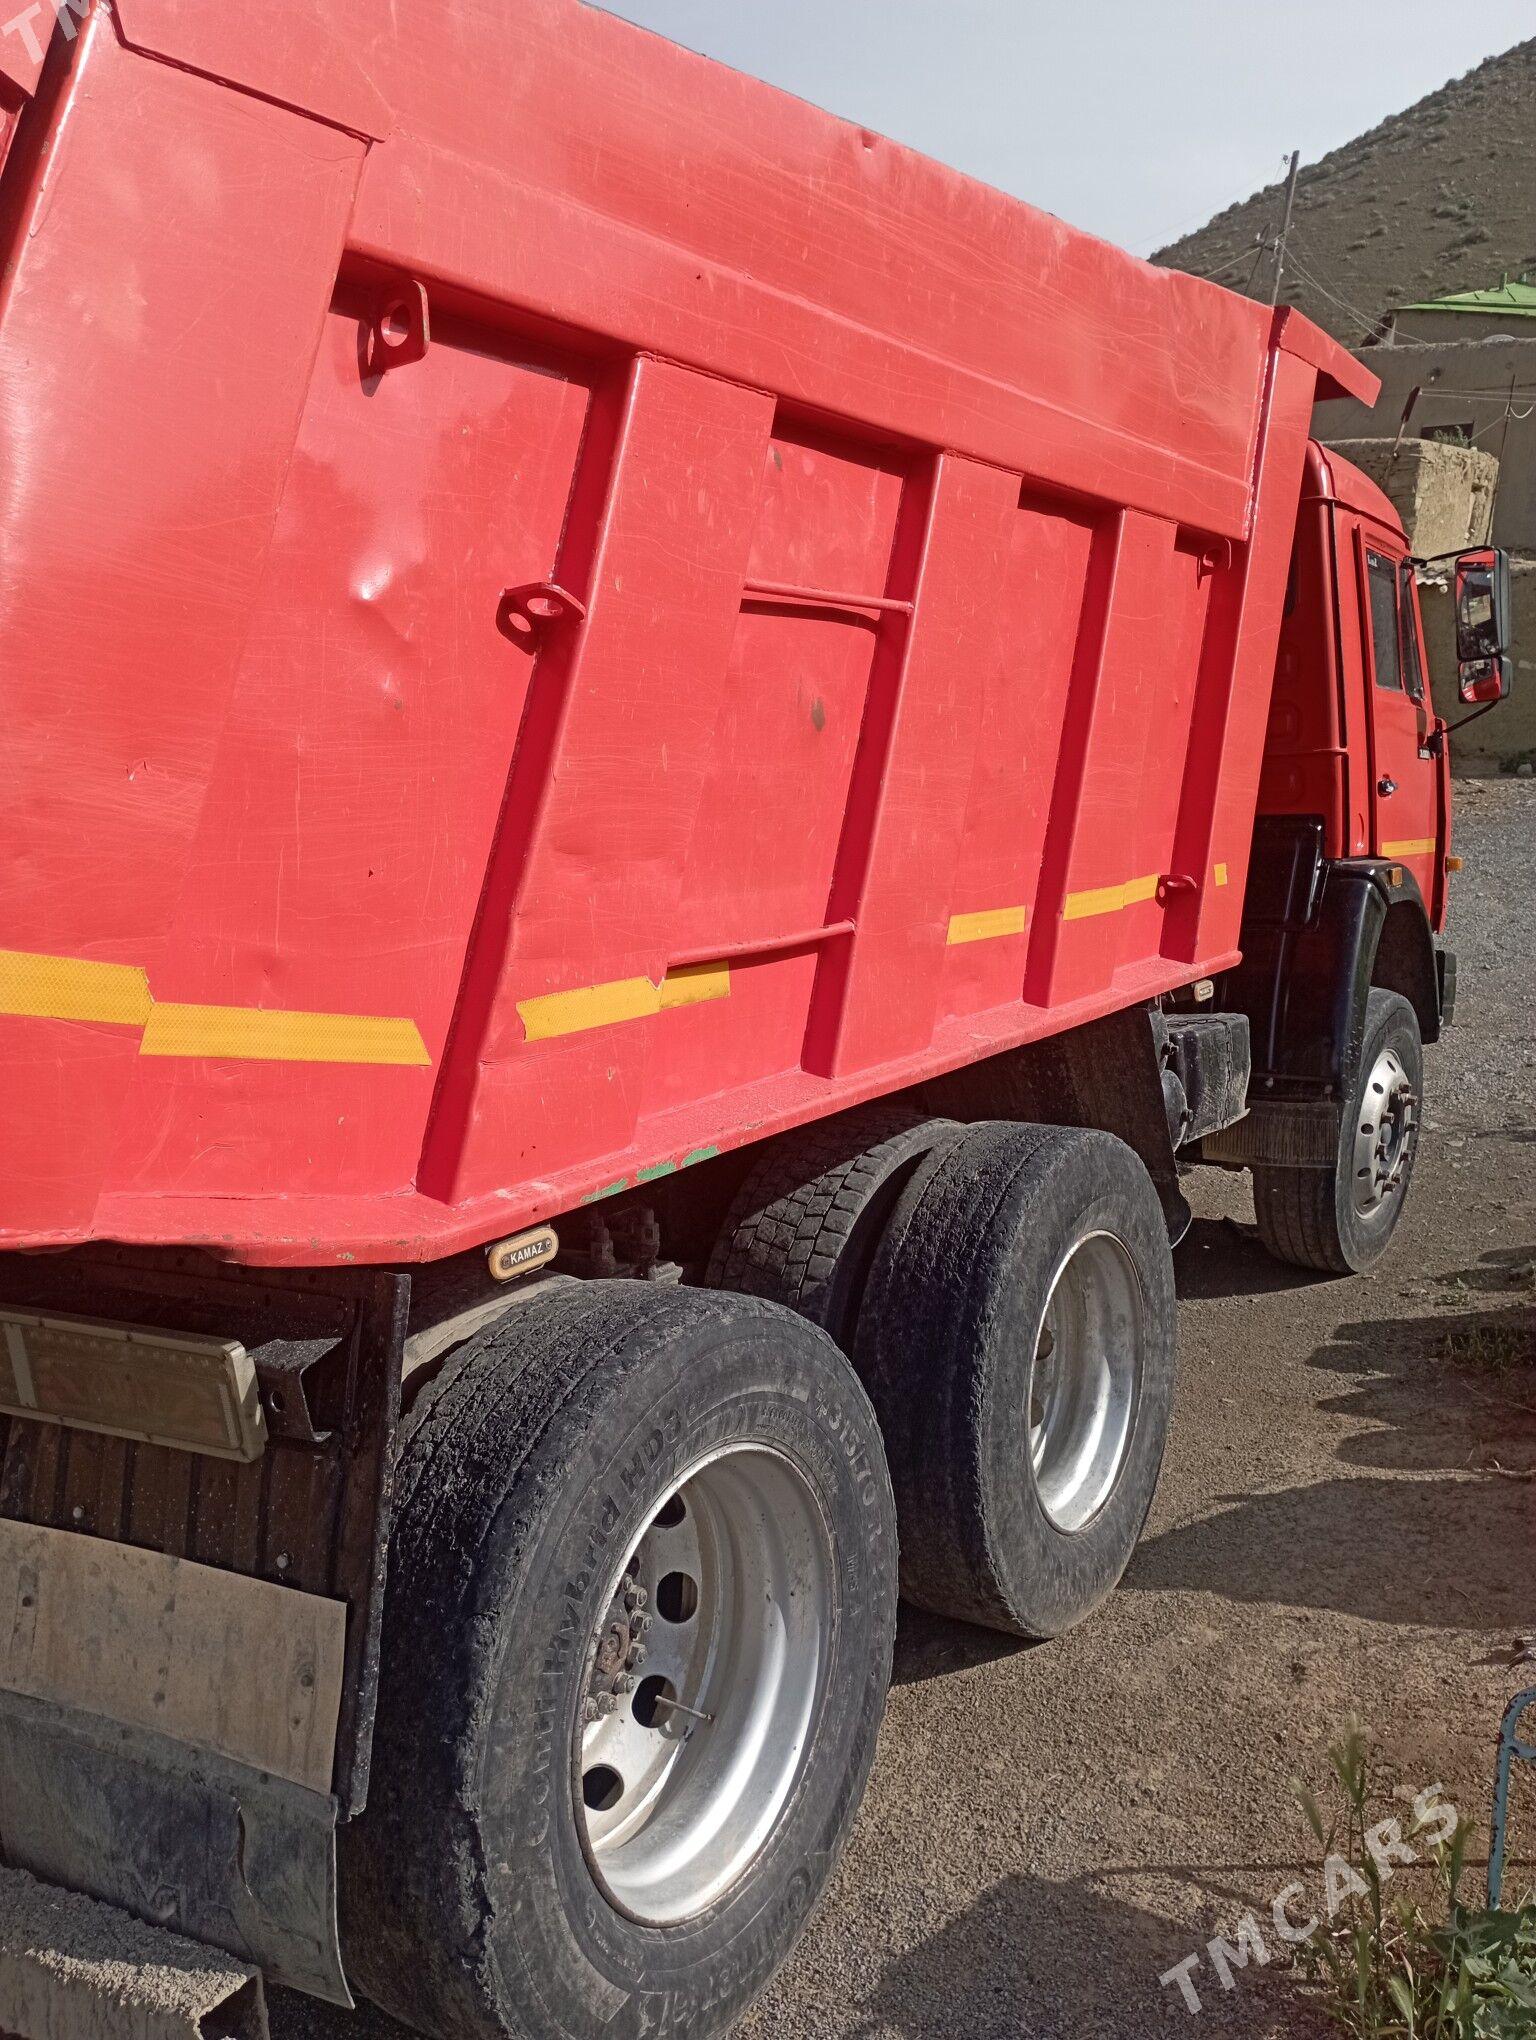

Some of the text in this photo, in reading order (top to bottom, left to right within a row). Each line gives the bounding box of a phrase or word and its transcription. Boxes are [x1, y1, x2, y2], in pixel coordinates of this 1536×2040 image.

[510, 1242, 545, 1265] KAMAZ
[826, 1400, 877, 1507] 315/70
[542, 1493, 622, 1676] Hybrid
[618, 1408, 682, 1498] HD3
